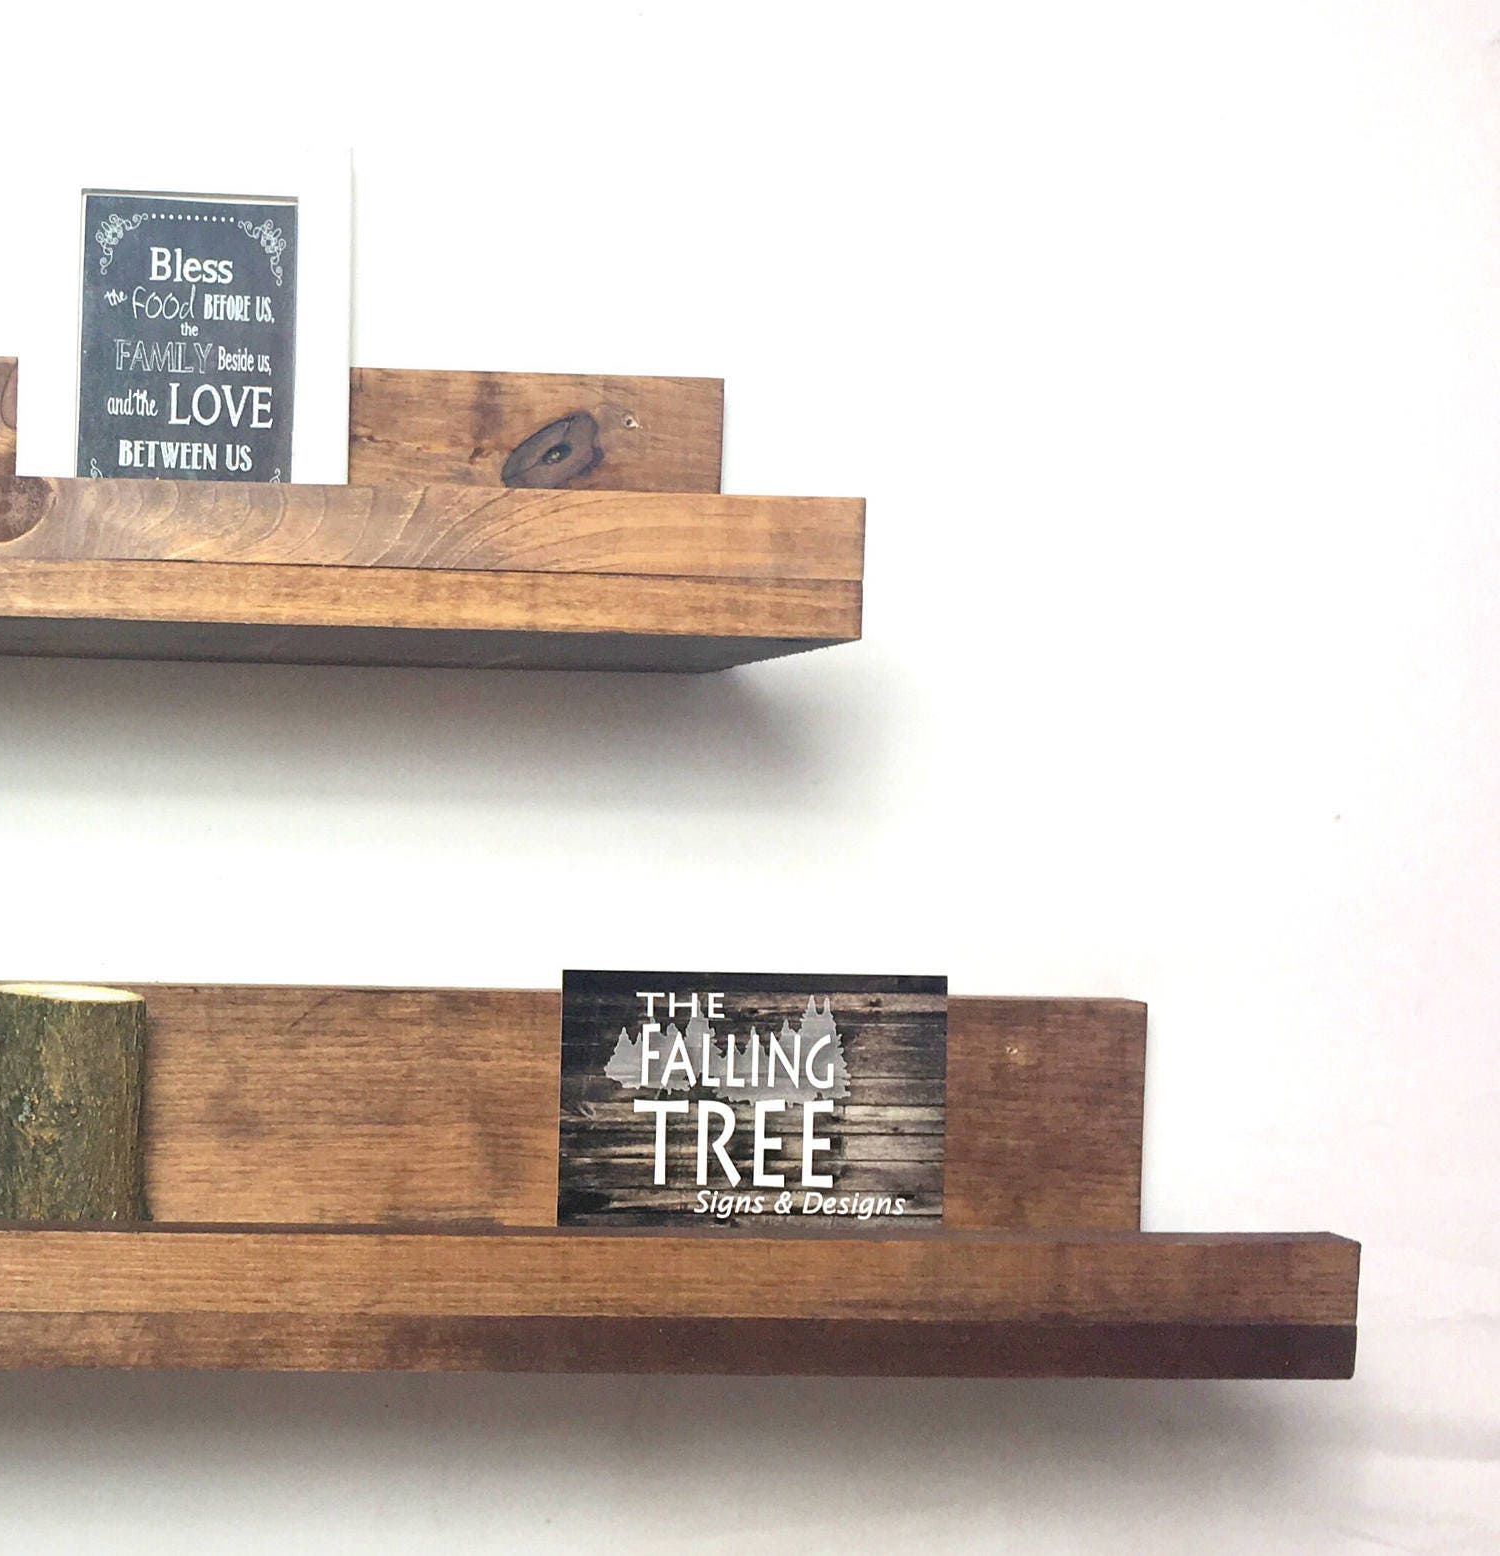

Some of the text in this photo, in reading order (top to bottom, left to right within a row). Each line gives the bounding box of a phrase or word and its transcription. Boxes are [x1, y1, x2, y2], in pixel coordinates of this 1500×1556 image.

[150, 247, 233, 284] Bless
[104, 289, 127, 306] the
[204, 294, 250, 321] BEFORE
[181, 322, 199, 336] the
[115, 339, 272, 376] FAMILY Beside us,
[107, 383, 273, 429] and the LOVE
[119, 440, 252, 471] BETWEEN US
[636, 992, 725, 1019] THE
[640, 1023, 834, 1088] FALLING
[633, 1100, 834, 1188] TREE
[693, 1191, 906, 1220] Signs & Designs
